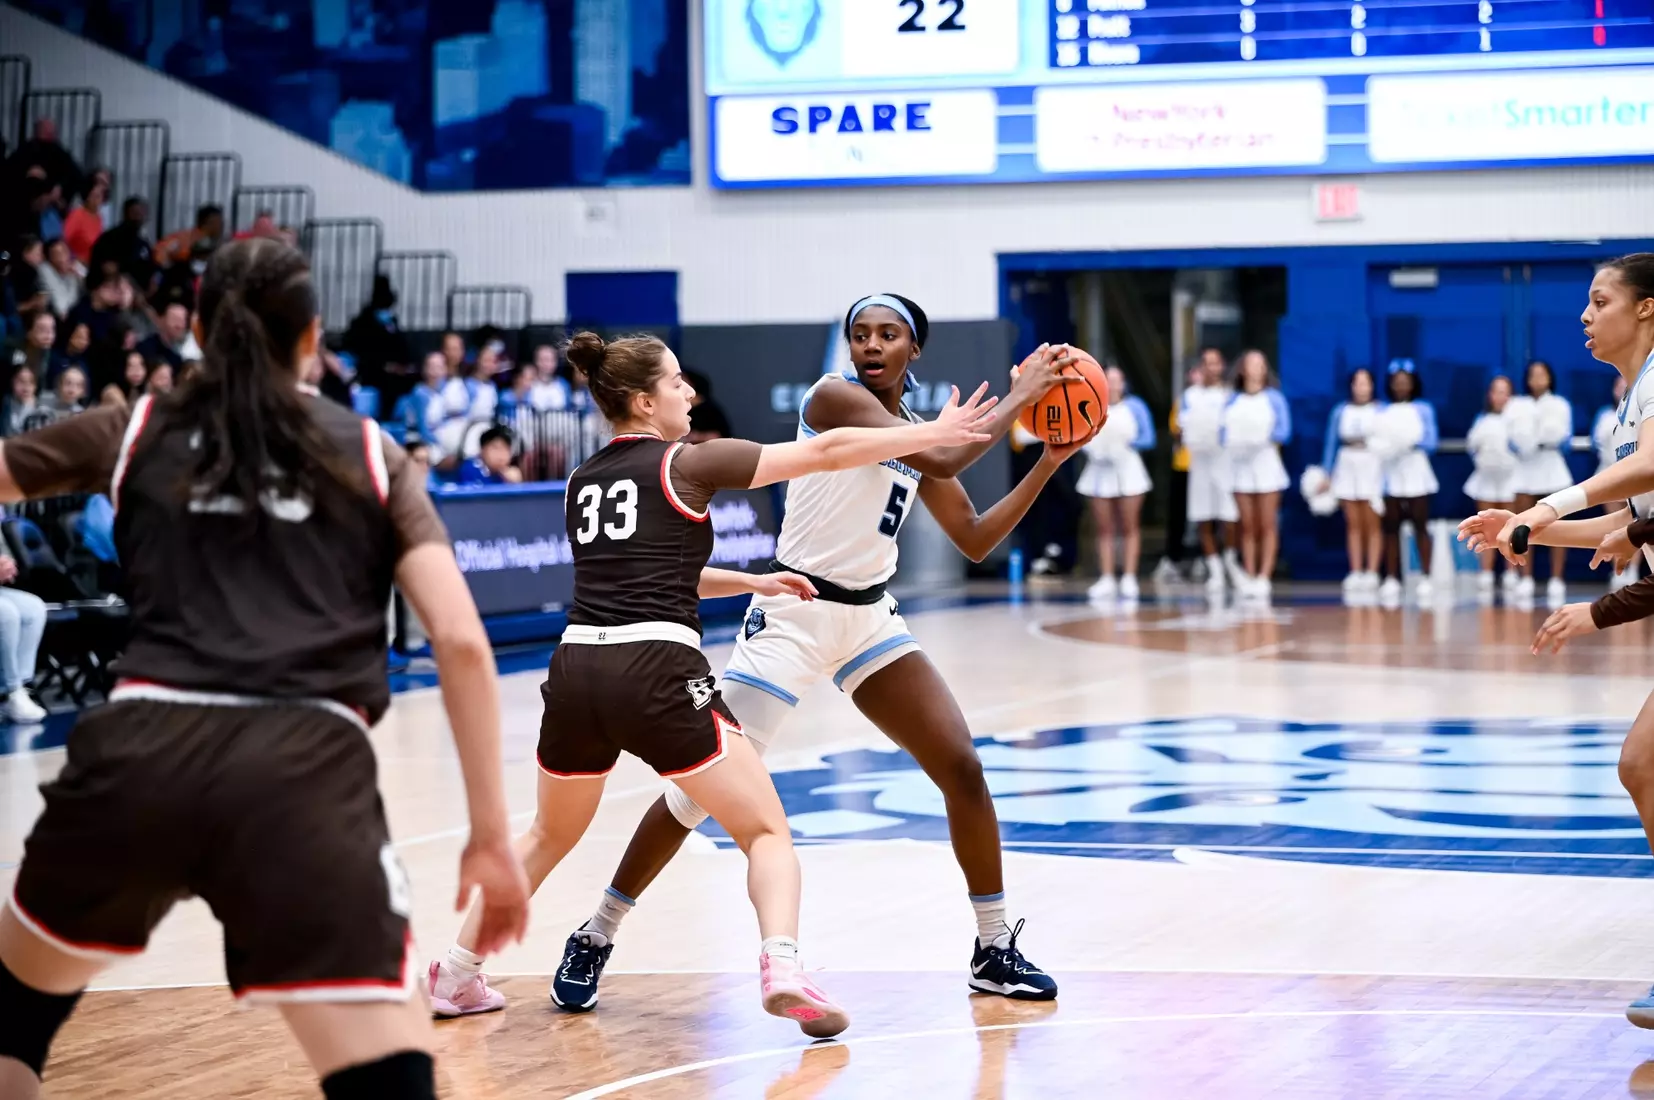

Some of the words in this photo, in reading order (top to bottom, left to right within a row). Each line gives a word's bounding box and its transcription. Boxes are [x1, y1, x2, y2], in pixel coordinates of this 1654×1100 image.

[897, 0, 967, 32] 22
[772, 103, 932, 135] SPARE
[1046, 405, 1063, 443] ELITE
[576, 479, 639, 545] 33
[877, 481, 909, 539] 5
